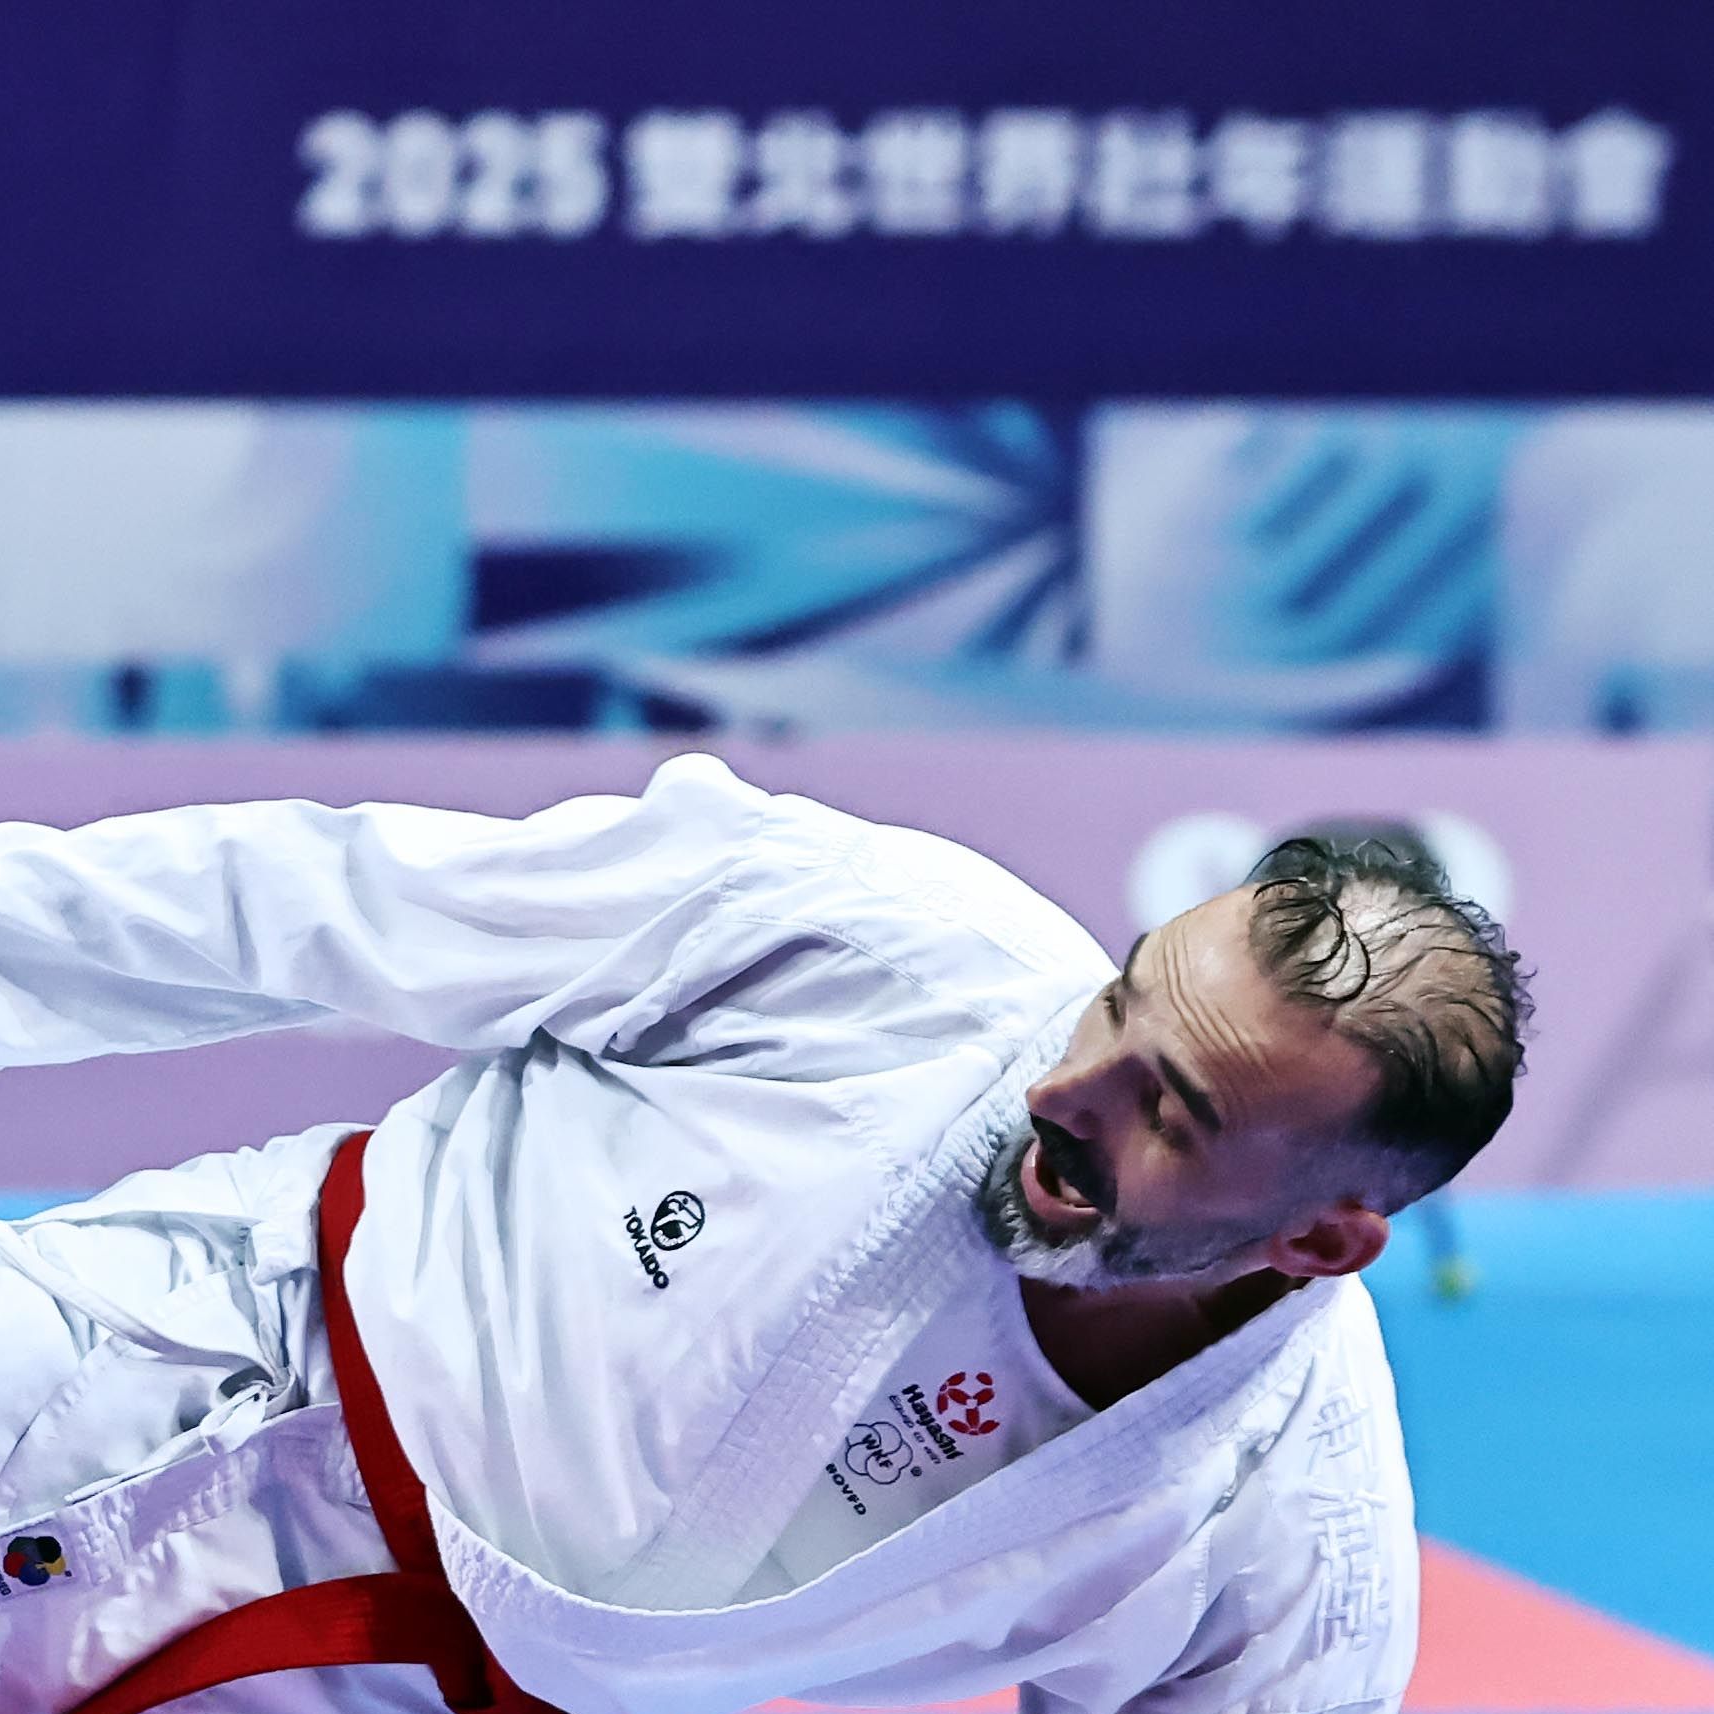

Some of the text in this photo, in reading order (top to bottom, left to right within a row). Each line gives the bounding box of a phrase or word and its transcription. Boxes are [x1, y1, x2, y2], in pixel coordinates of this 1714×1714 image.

[301, 111, 607, 235] 2025
[623, 1205, 670, 1290] TOKAIDO
[861, 1433, 894, 1469] WKF
[901, 1383, 965, 1461] Hayashi
